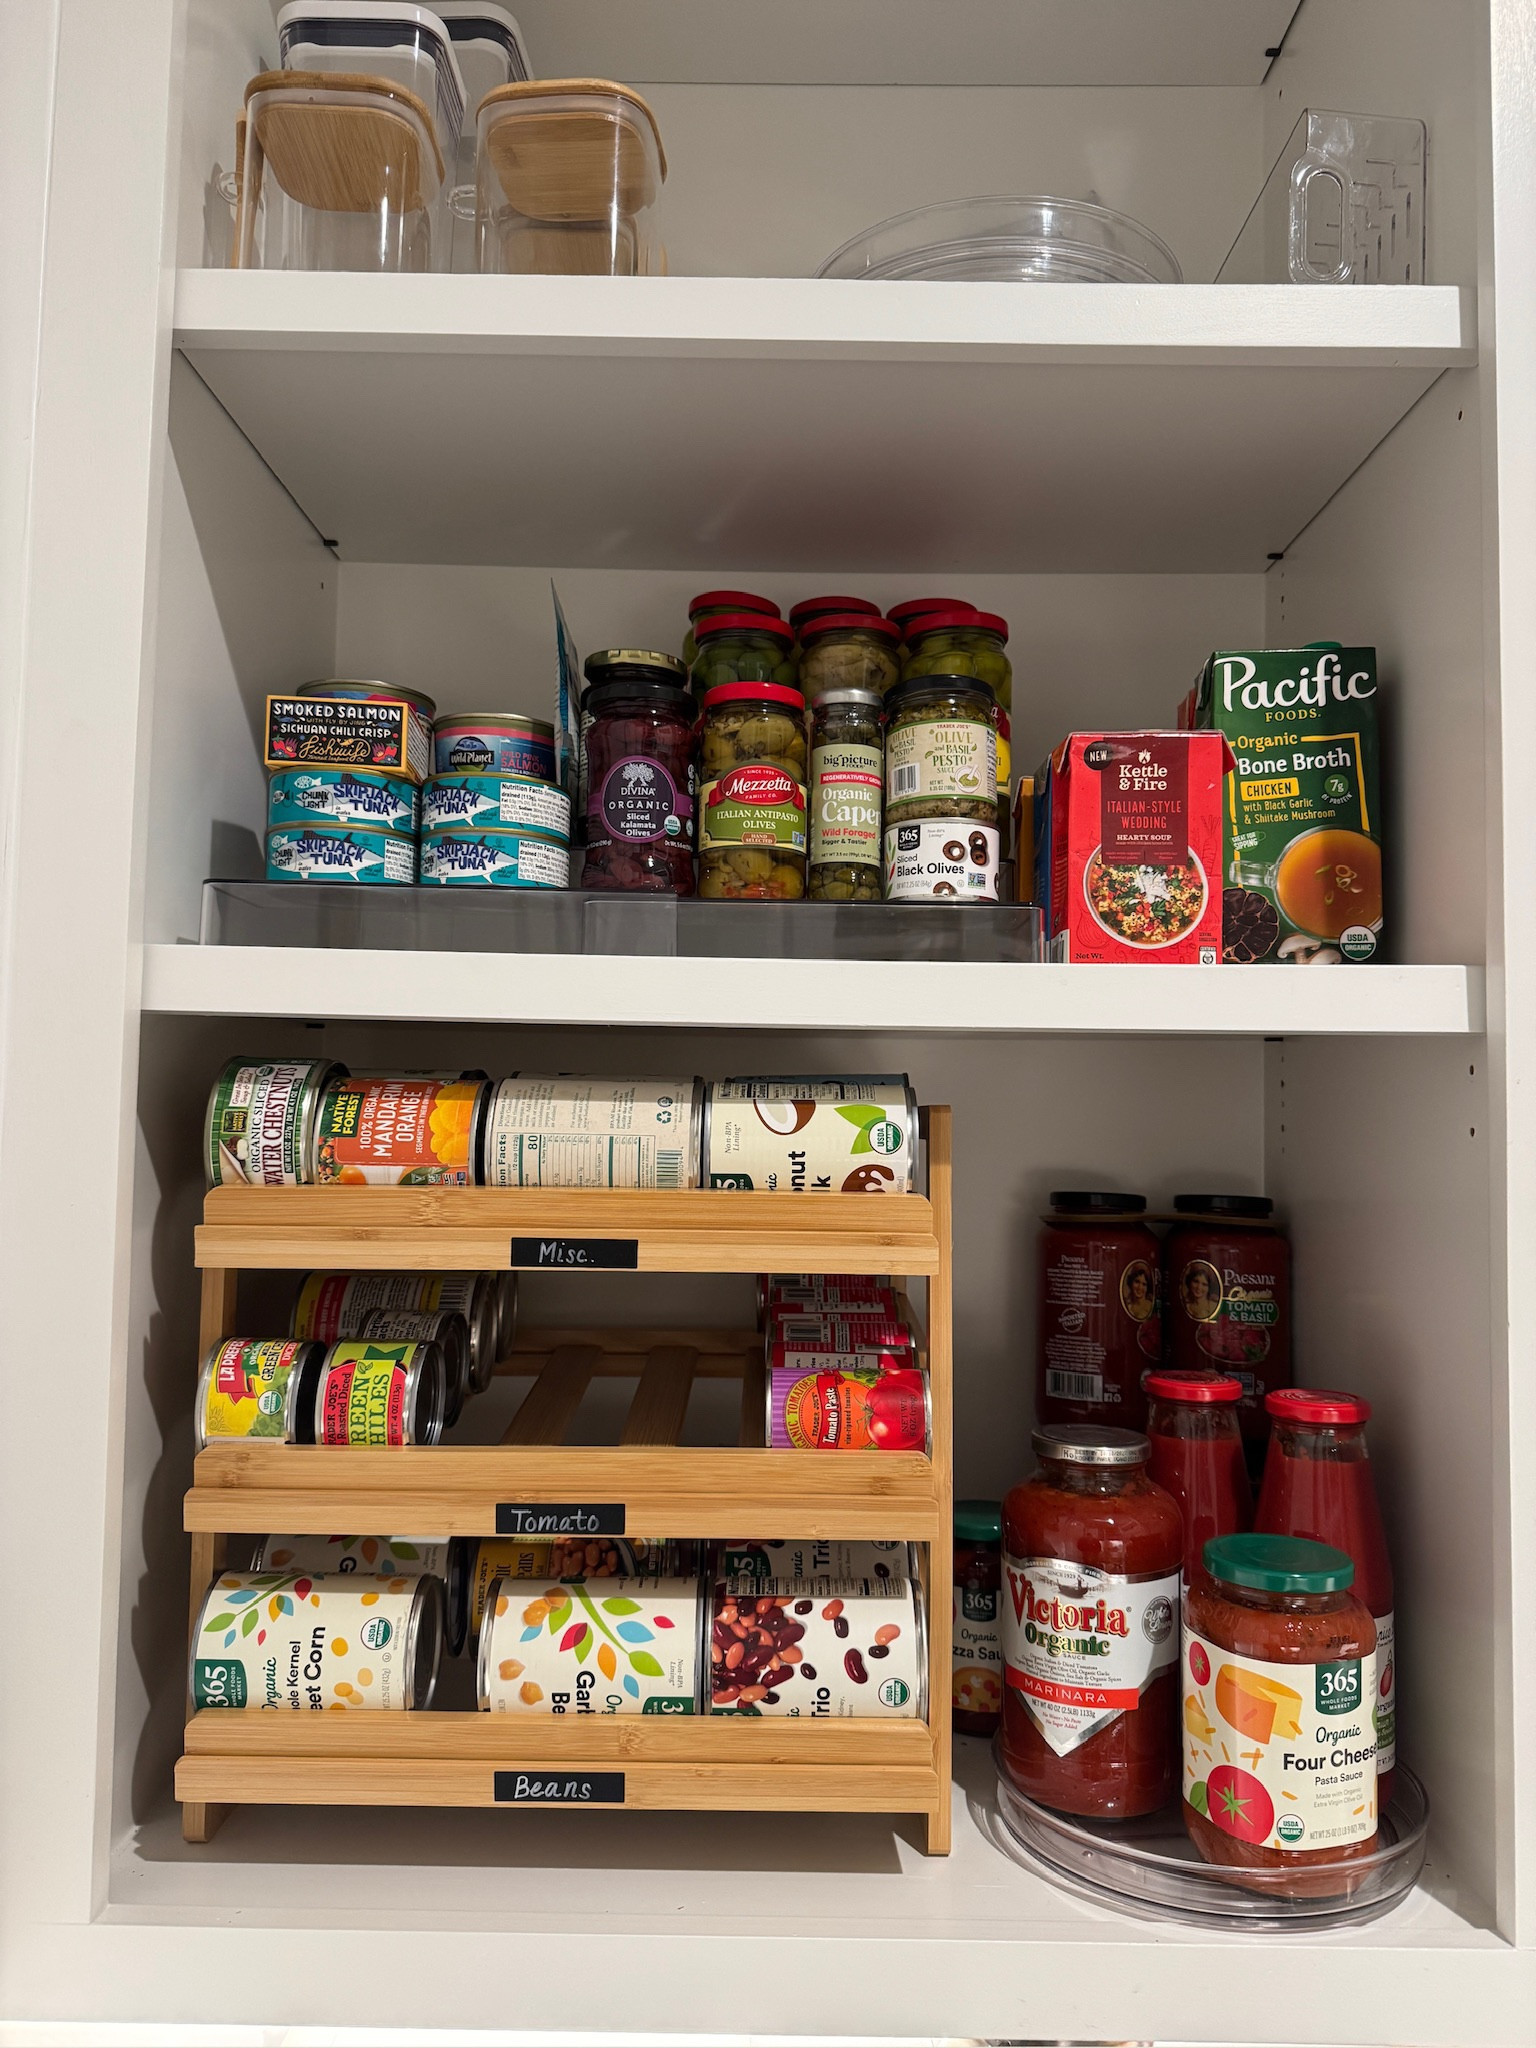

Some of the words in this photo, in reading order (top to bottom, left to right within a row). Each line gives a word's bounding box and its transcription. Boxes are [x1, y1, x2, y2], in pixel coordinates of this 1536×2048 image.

[1214, 654, 1377, 712] Pacific
[273, 703, 334, 717] SMOKED
[338, 705, 401, 721] SALMON
[281, 723, 327, 735] SICHUAN
[330, 726, 356, 737] CHILI
[359, 728, 391, 738] CRISP
[935, 732, 973, 743] OLIVE
[299, 735, 371, 762] Fishwife
[946, 745, 971, 754] BASIL
[1237, 733, 1298, 752] Organic
[451, 753, 466, 763] Wild
[467, 752, 493, 764] Planet
[501, 751, 521, 759] WILD
[523, 753, 539, 761] PINK
[824, 755, 839, 767] big
[840, 754, 877, 767] picture
[933, 755, 967, 766] PESTO
[1090, 750, 1107, 763] NEW
[1239, 758, 1287, 775] Bone
[1293, 748, 1351, 771] Broth
[501, 758, 546, 774] SALMON
[1119, 764, 1168, 778] Kettle
[502, 784, 527, 792] Nutrition
[726, 777, 792, 796] Mezzetta
[1119, 779, 1130, 790] &
[1134, 778, 1167, 790] Fire
[1247, 782, 1292, 796] CHICKEN
[1330, 780, 1344, 792] 7g
[302, 791, 329, 801] CHUNK
[333, 783, 400, 813] SKIPJACK
[428, 788, 480, 808] SKIPJACK
[823, 788, 872, 802] Organic
[302, 800, 327, 809] LIGHT
[350, 800, 390, 816] TUNA
[435, 801, 468, 815] TUNA
[608, 801, 669, 810] ORGANIC
[1107, 800, 1182, 813] ITALIAN-STYLE
[1243, 801, 1261, 812] with
[1265, 800, 1286, 810] Black
[1290, 797, 1313, 808] Garlic
[621, 821, 656, 829] Kalamata
[717, 810, 751, 820] ITALIAN
[754, 810, 799, 823] ANTIPASTO
[743, 820, 776, 829] OLIVES
[1121, 816, 1167, 829] WEDDING
[1244, 816, 1251, 824] &
[1255, 813, 1288, 823] Shiitake
[1292, 810, 1336, 821] Mushroom
[822, 828, 841, 837] Wild
[843, 828, 876, 839] Foraged
[899, 829, 918, 843] 365
[296, 839, 367, 863] SKIPJACK
[386, 840, 404, 848] Nutrition
[520, 841, 542, 850] Nutrition
[1234, 839, 1258, 850] SIPPING
[310, 853, 353, 867] TUNA
[437, 843, 499, 864] SKIPJACK
[897, 854, 917, 864] Sliced
[448, 858, 487, 870] TUNA
[897, 864, 924, 877] Black
[927, 862, 964, 875] Olives
[1347, 934, 1368, 942] USDA
[254, 1080, 270, 1115] SLICED
[262, 1068, 297, 1140] CHESTNUTS
[364, 1086, 383, 1119] ORGANIC
[331, 1094, 349, 1132] NATIVE
[342, 1094, 360, 1135] FOREST
[373, 1083, 405, 1157] MANDARIN
[395, 1091, 422, 1142] ORANGE
[360, 1121, 373, 1149] 100%
[416, 1123, 425, 1154] SEGMENTS
[528, 1136, 538, 1150] 80
[877, 1127, 885, 1147] USDA
[251, 1117, 262, 1173] ORGANIC
[498, 1134, 506, 1165] Facts
[539, 1242, 594, 1264] Misc.
[1224, 1269, 1276, 1286] Paesana
[1227, 1301, 1274, 1312] TOMATO
[1229, 1313, 1239, 1322] &
[1241, 1311, 1272, 1323] BASIL
[220, 1366, 235, 1381] LA
[261, 1352, 280, 1381] GREEN
[339, 1373, 352, 1399] Diced
[393, 1384, 401, 1403] (113g)
[787, 1377, 815, 1415] TOMATOES
[825, 1388, 838, 1410] Paste
[351, 1376, 371, 1443] REEN
[369, 1374, 390, 1445] HILES
[392, 1404, 398, 1414] OZ
[337, 1403, 346, 1439] Roasted
[822, 1411, 838, 1443] Tomato
[511, 1509, 599, 1532] Tomato
[965, 1593, 993, 1611] 365
[1010, 1572, 1129, 1638] Victoria
[368, 1624, 376, 1642] USDA
[377, 1622, 385, 1645] ORGANIC
[961, 1628, 998, 1643] Organic
[1025, 1622, 1110, 1657] Organic
[304, 1626, 326, 1680] Corn
[953, 1645, 975, 1658] zza
[287, 1641, 301, 1687] Kernel
[202, 1666, 229, 1706] 365
[1024, 1678, 1107, 1703] MARINARA
[1320, 1667, 1358, 1697] 365
[1032, 1699, 1040, 1707] NET
[1041, 1701, 1047, 1709] WT
[1062, 1706, 1079, 1716] (2.5LB)
[1080, 1708, 1095, 1718] 1133g
[1316, 1724, 1362, 1746] Organic
[1283, 1752, 1327, 1771] Four
[514, 1776, 592, 1799] Beans
[1315, 1776, 1338, 1786] Pasta
[1340, 1772, 1363, 1782] Sauce
[1281, 1828, 1301, 1836] ORGANIC
